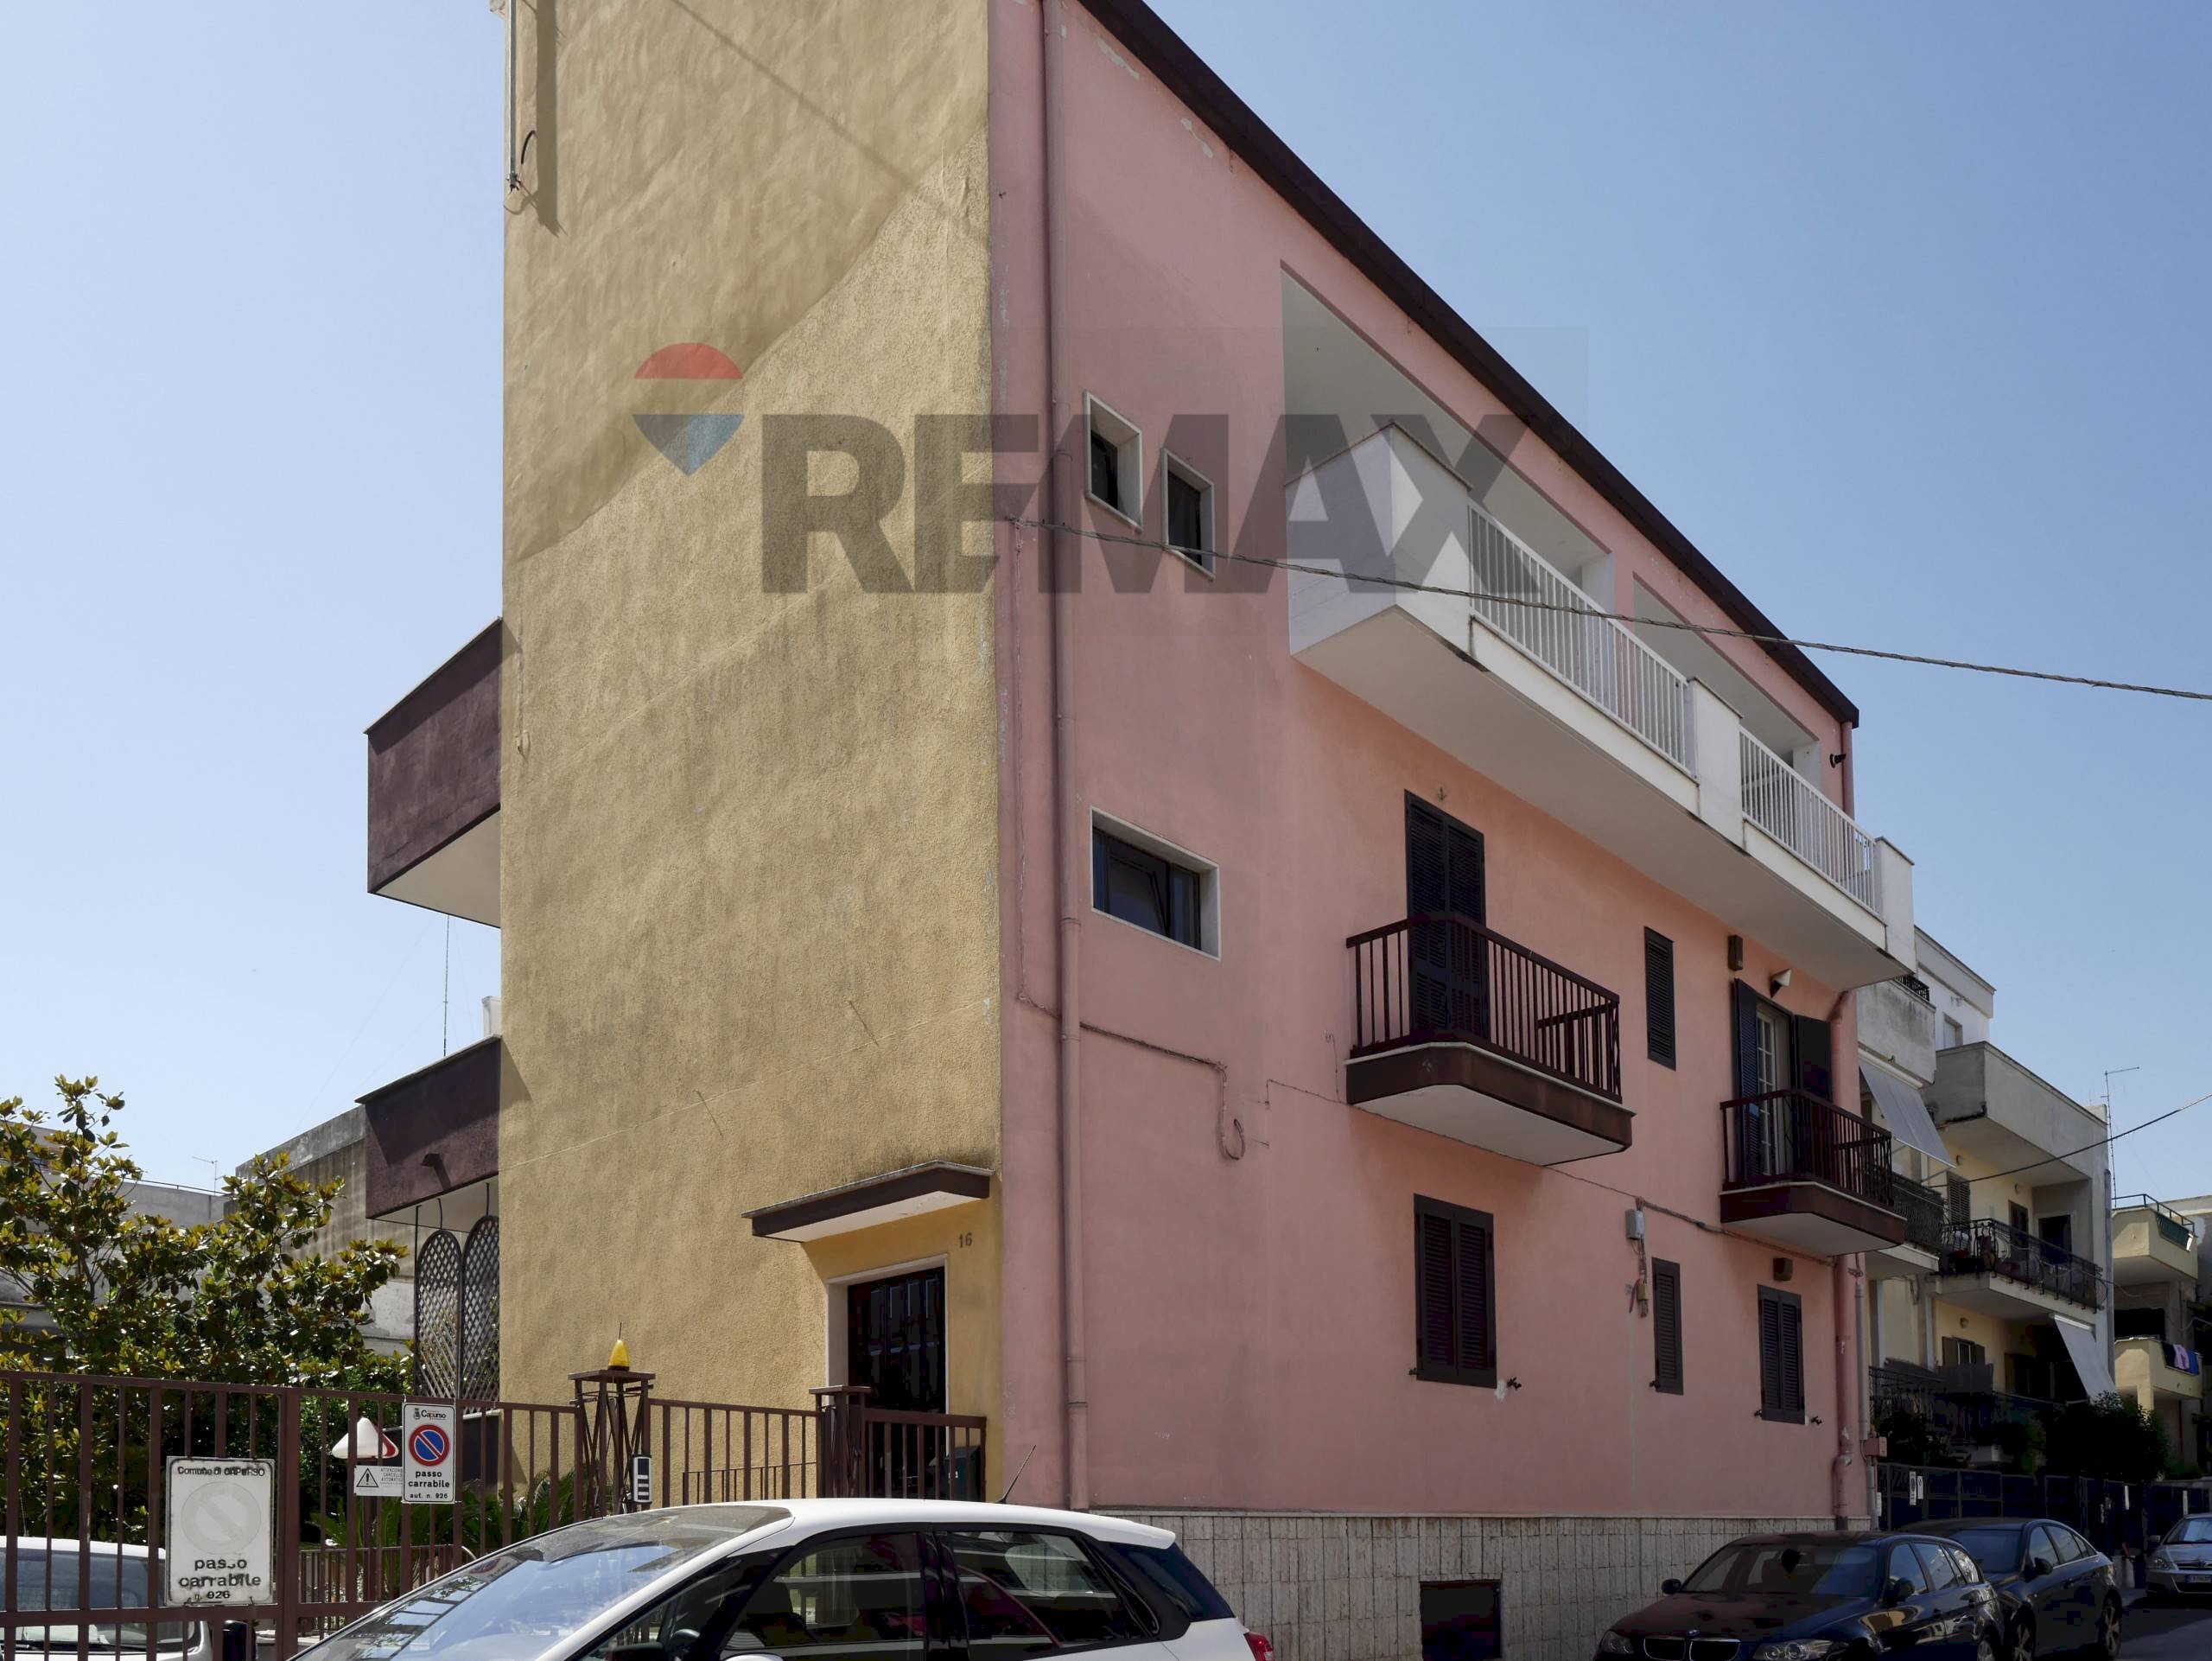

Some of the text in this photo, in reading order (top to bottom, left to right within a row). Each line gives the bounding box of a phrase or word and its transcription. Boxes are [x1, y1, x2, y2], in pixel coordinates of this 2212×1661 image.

[958, 1232, 972, 1248] 16
[421, 1410, 447, 1420] Capurso
[177, 1467, 213, 1475] Comune
[179, 1574, 261, 1588] carrabile
[207, 1590, 230, 1599] 926
